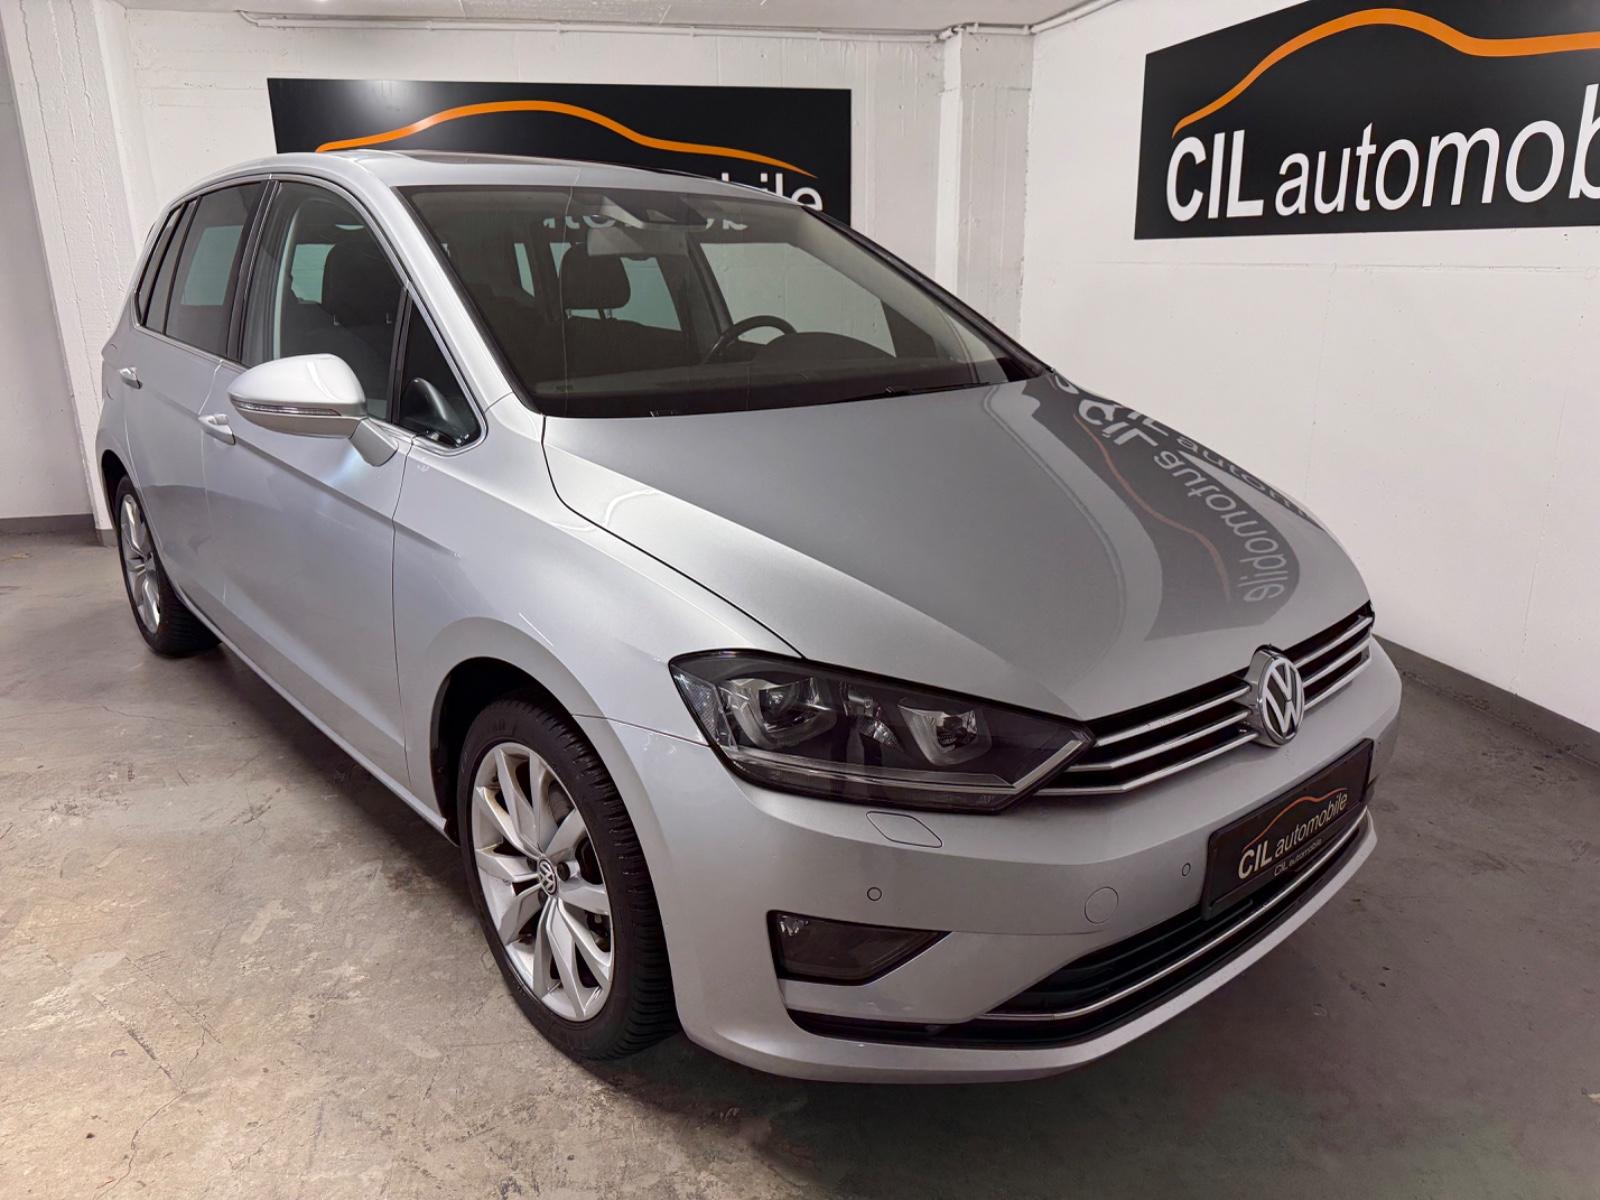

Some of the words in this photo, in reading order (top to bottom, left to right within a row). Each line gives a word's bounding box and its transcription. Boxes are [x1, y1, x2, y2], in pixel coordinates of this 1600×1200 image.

[1166, 129, 1264, 222] CIL
[1238, 841, 1273, 879] CIL
[1275, 792, 1348, 858] automobile
